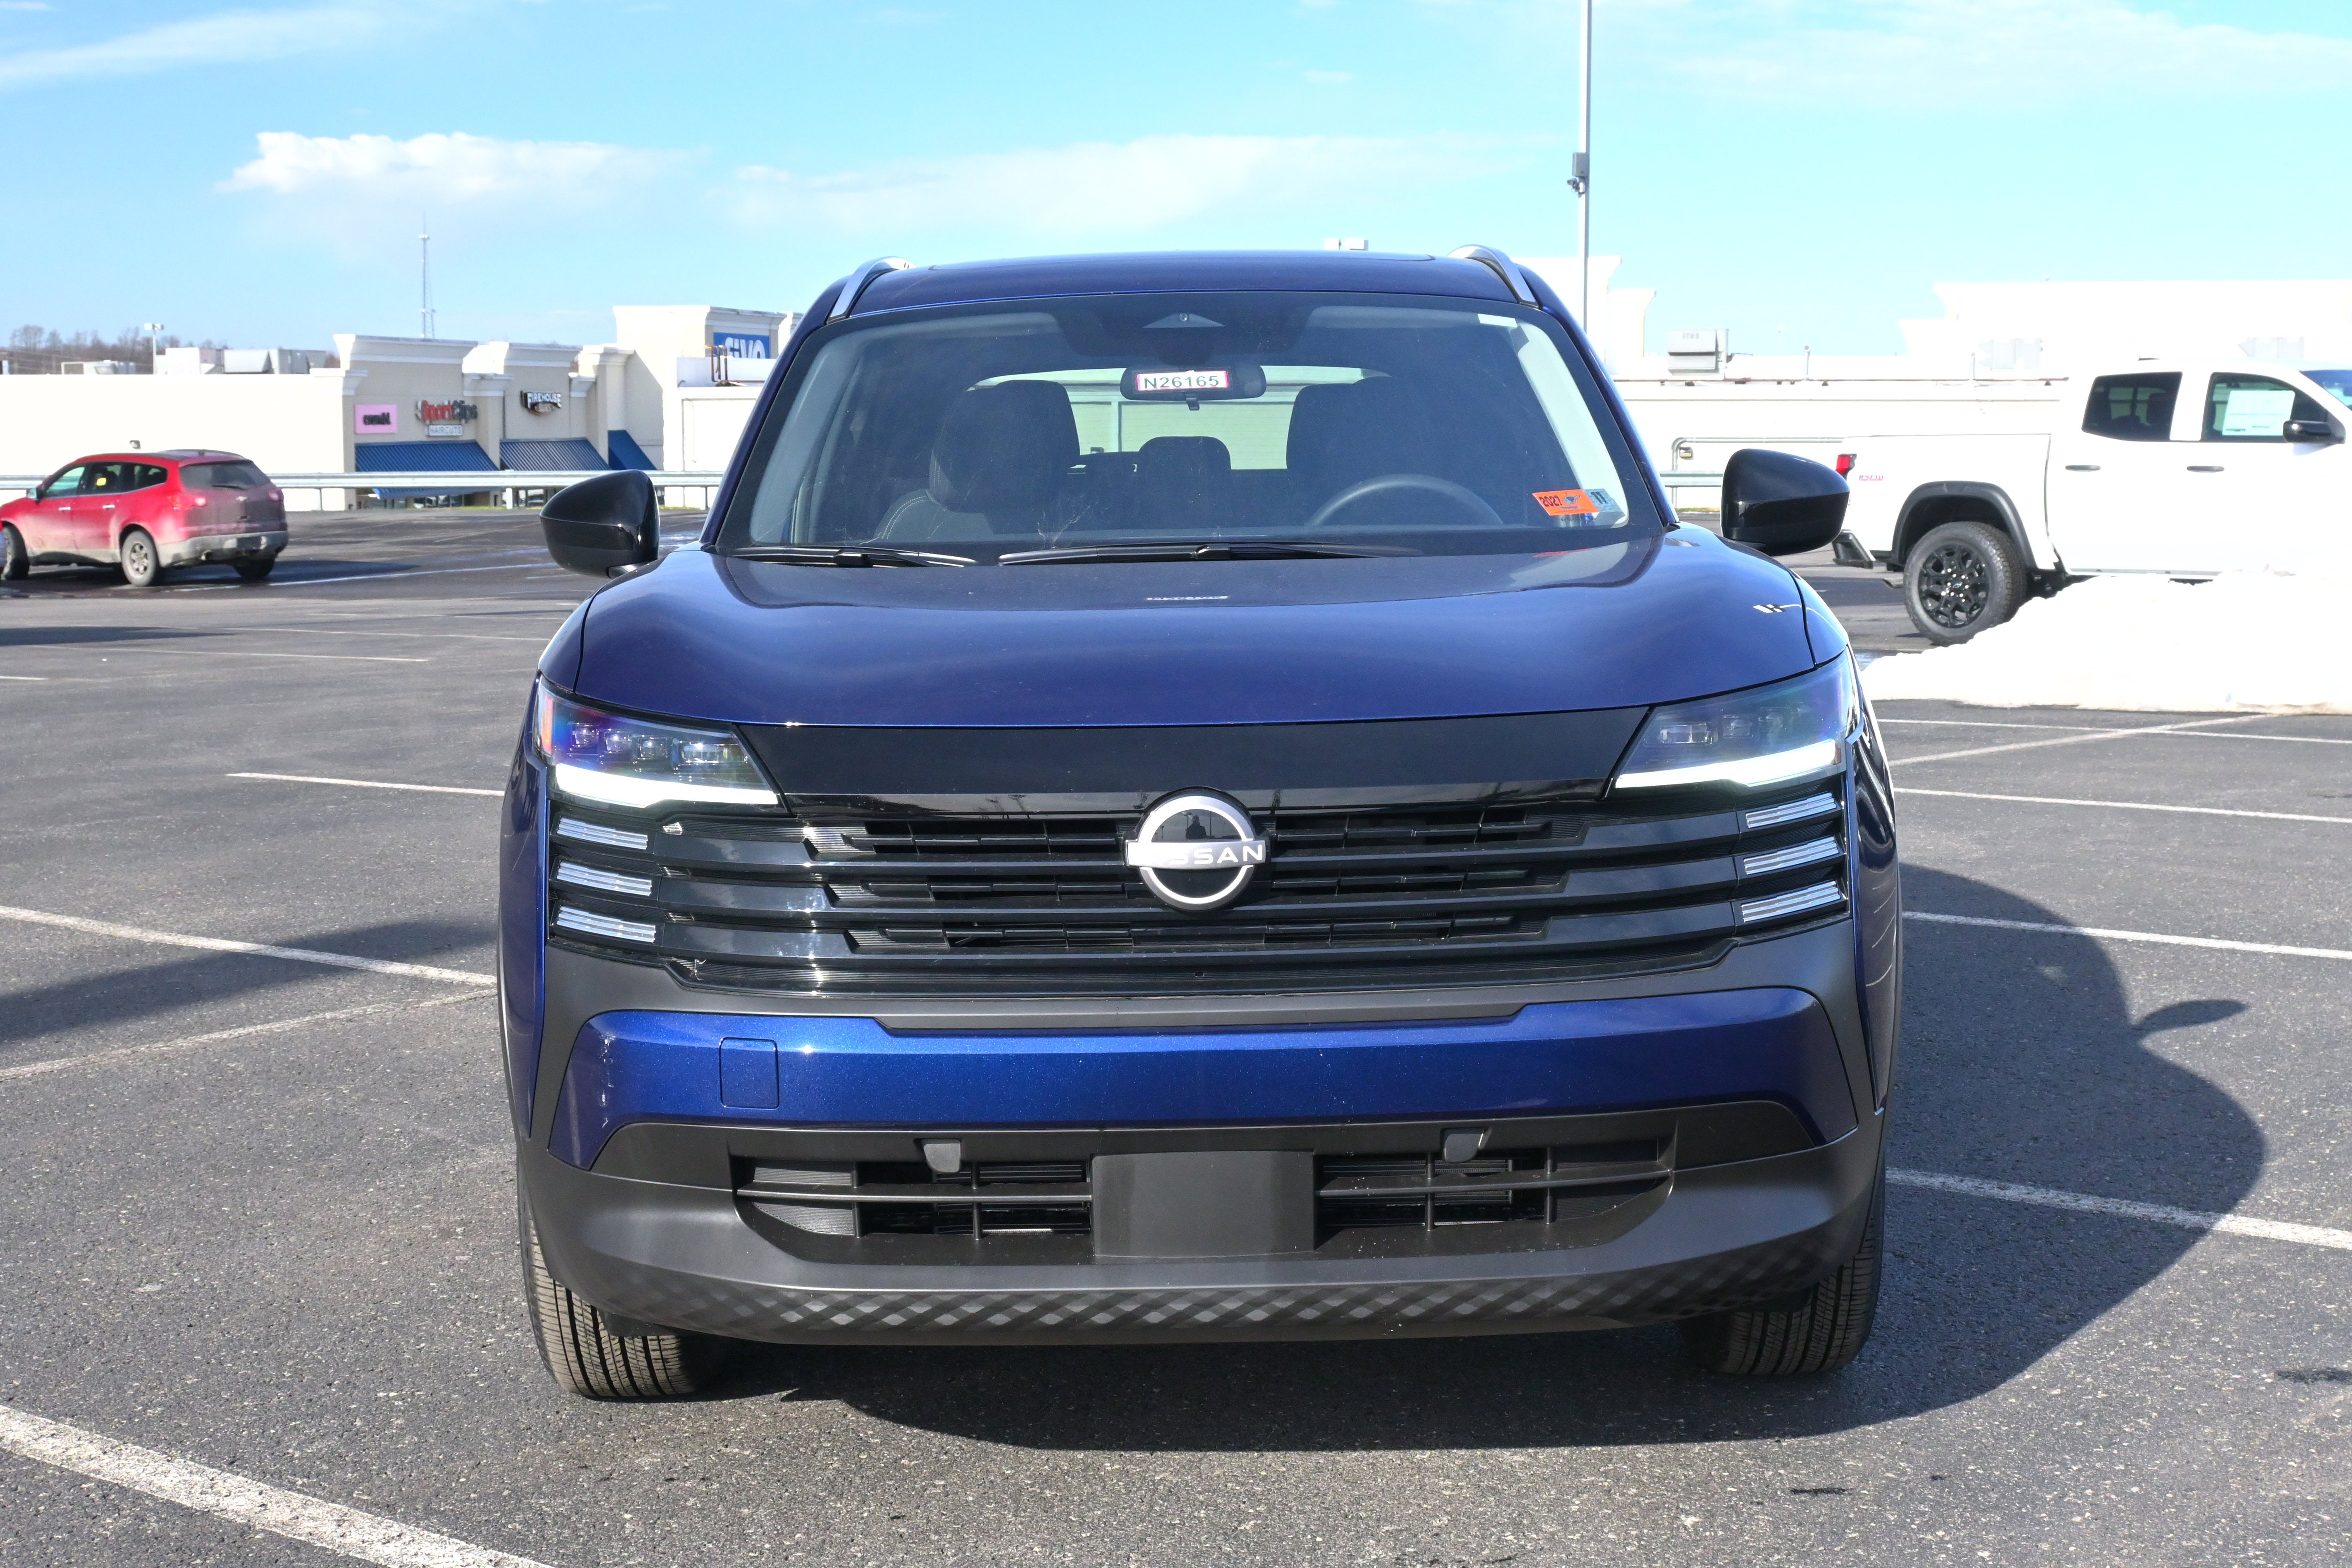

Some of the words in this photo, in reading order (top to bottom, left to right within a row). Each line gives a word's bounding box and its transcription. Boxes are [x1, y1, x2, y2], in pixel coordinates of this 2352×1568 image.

[1144, 376, 1219, 389] N26165
[527, 393, 561, 408] FIREHOUSE
[430, 426, 461, 435] HAIRCUTS
[1539, 495, 1562, 507] 2027
[1590, 491, 1608, 504] 11
[1133, 844, 1263, 865] SSAN
